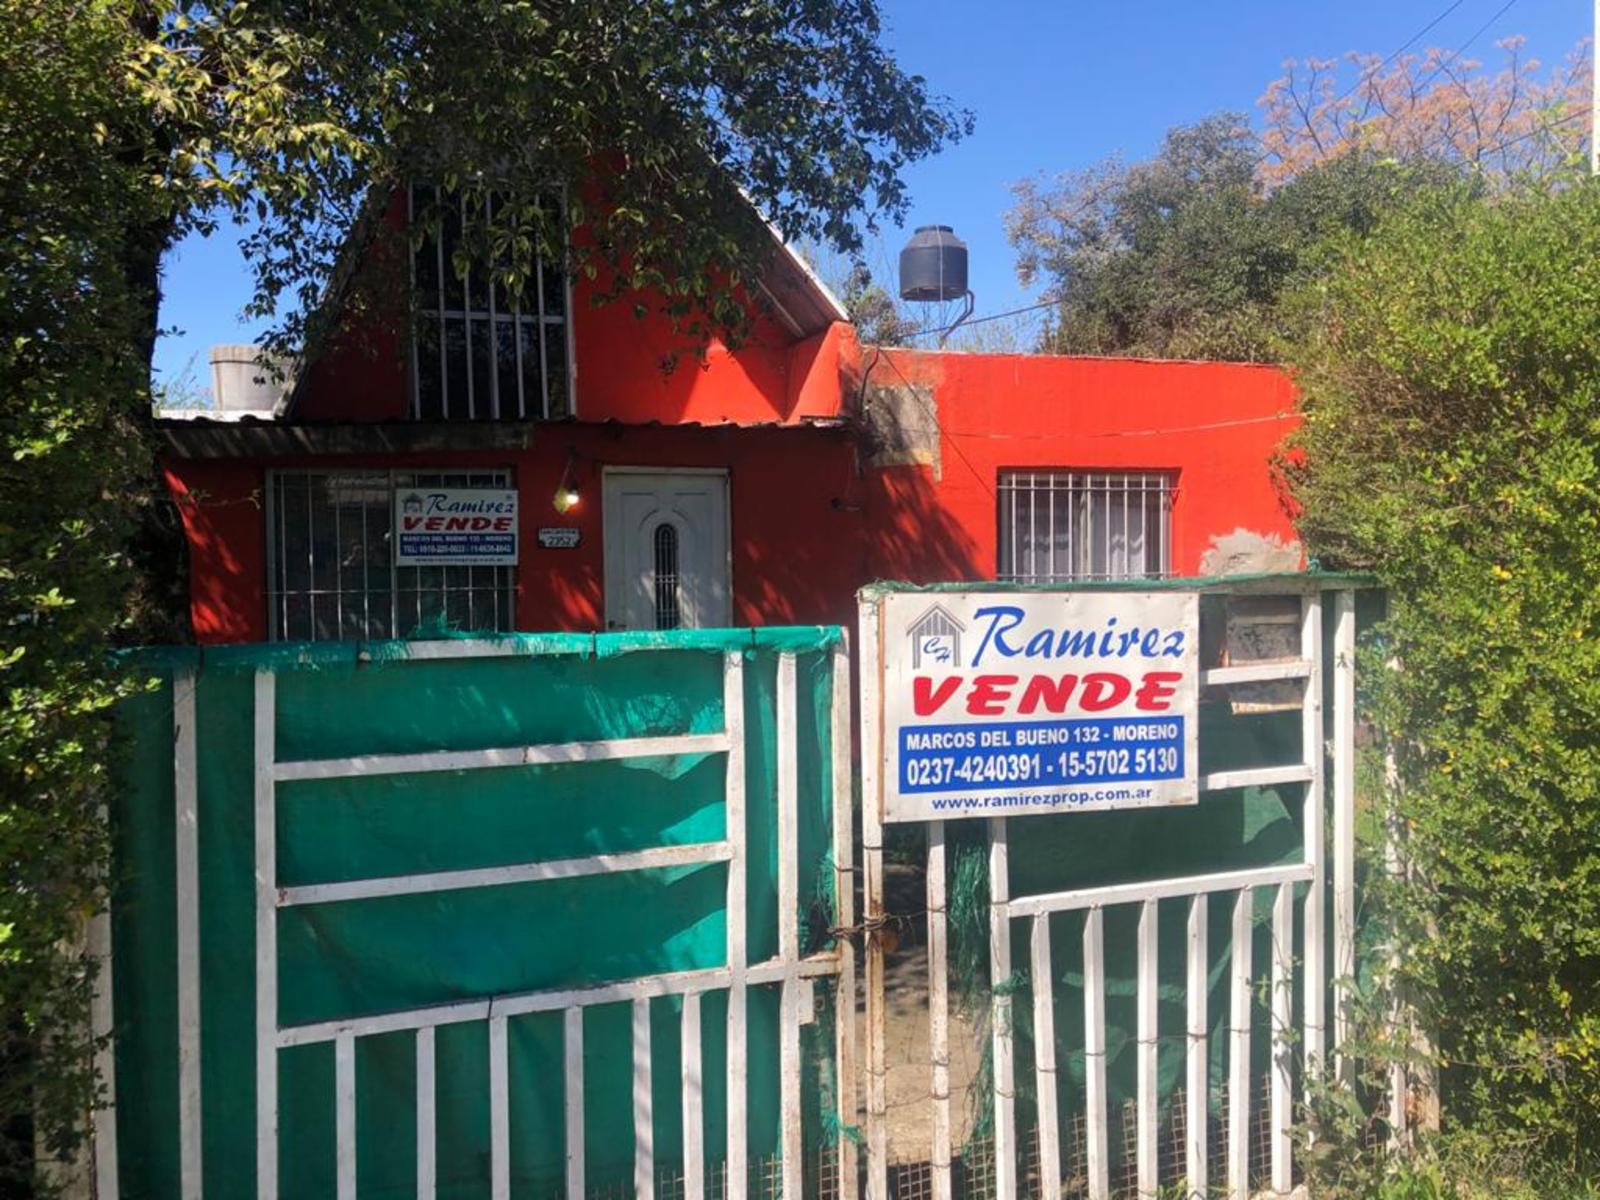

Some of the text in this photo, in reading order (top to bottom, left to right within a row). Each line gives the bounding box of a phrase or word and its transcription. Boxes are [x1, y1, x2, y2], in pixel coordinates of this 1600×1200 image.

[403, 517, 513, 531] VENDE
[971, 605, 1186, 668] Ramirez
[912, 671, 1184, 716] VENDE
[906, 732, 976, 751] MARCOS
[980, 730, 1011, 747] DEL
[1016, 728, 1069, 745] BUENO
[1073, 726, 1100, 743] 132
[1113, 723, 1178, 741] MORENO
[907, 753, 1040, 786] 0237-4240391
[1058, 749, 1129, 777] 15-5702
[1134, 746, 1178, 774] 5130
[931, 786, 1152, 811] www.ramirezprop.com.ar
